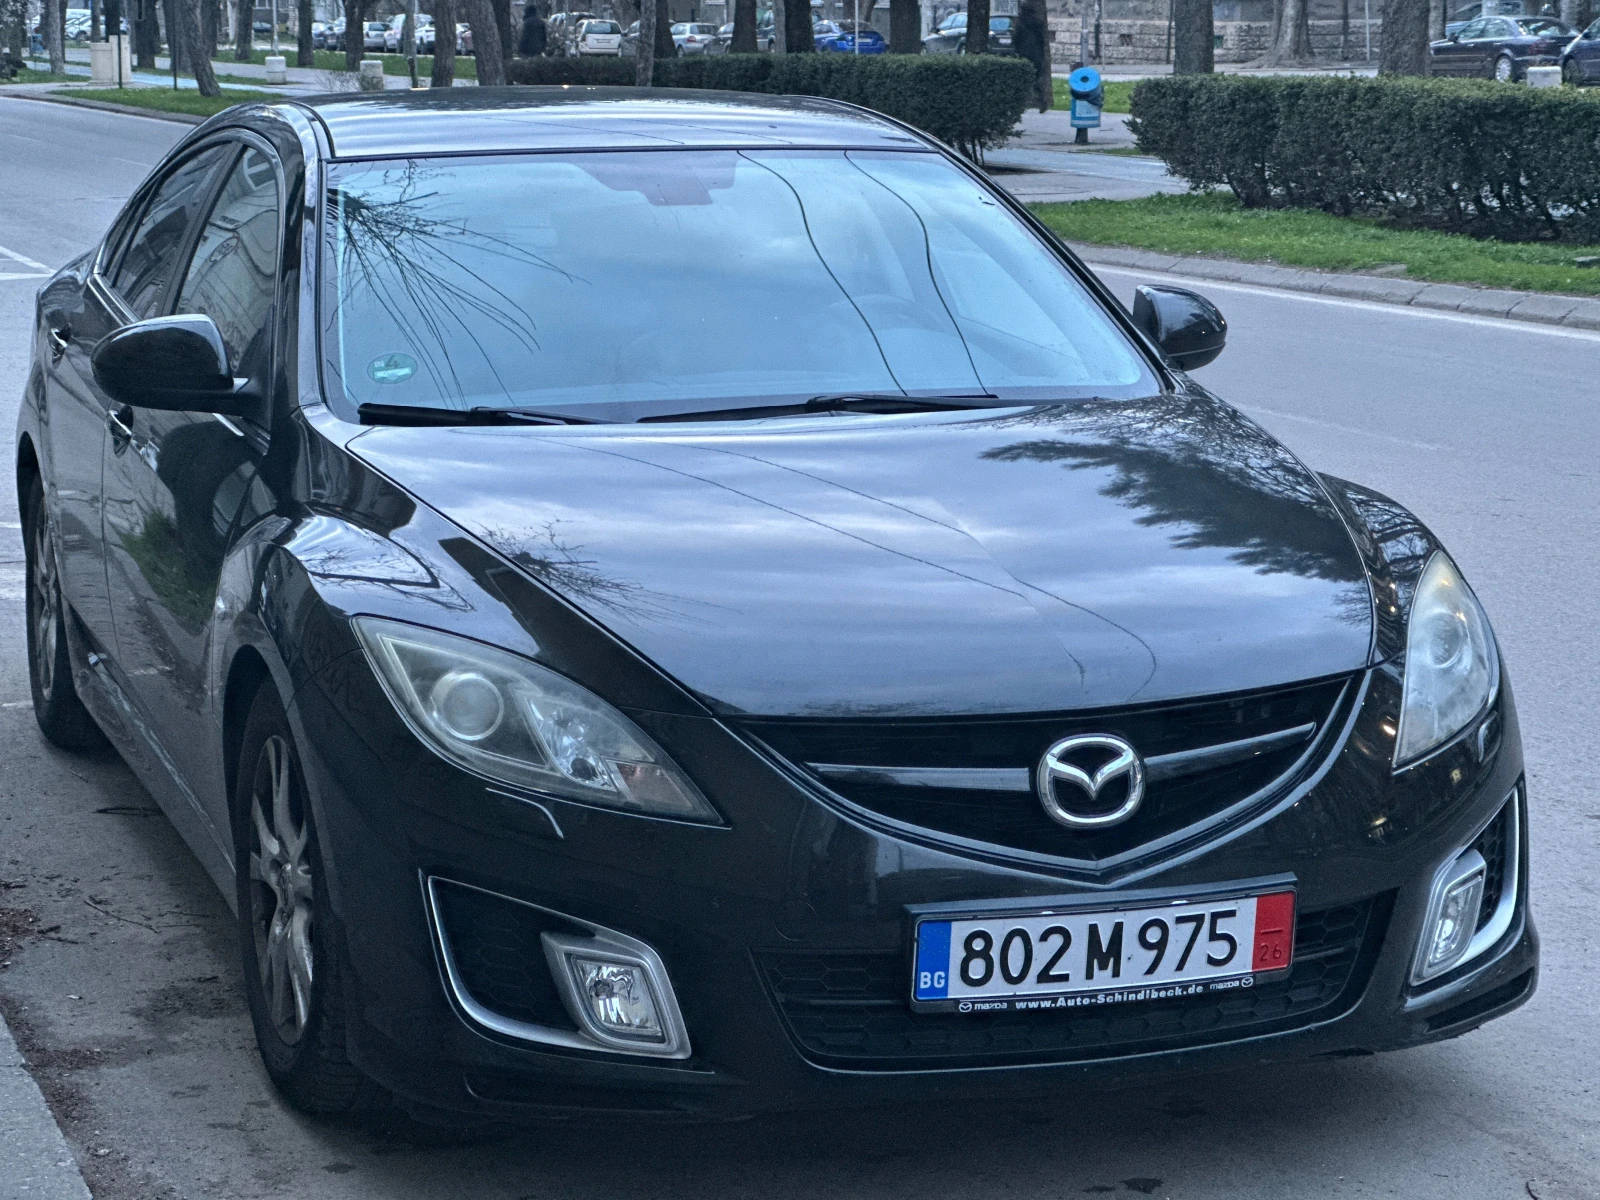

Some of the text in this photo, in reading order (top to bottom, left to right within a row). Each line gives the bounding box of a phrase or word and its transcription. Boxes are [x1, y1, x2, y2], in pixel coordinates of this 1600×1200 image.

[959, 909, 1237, 987] 802 M 975
[1259, 941, 1282, 961] 26
[919, 971, 946, 989] BG
[1015, 984, 1204, 1009] www.Auto-Schindlbeck.de
